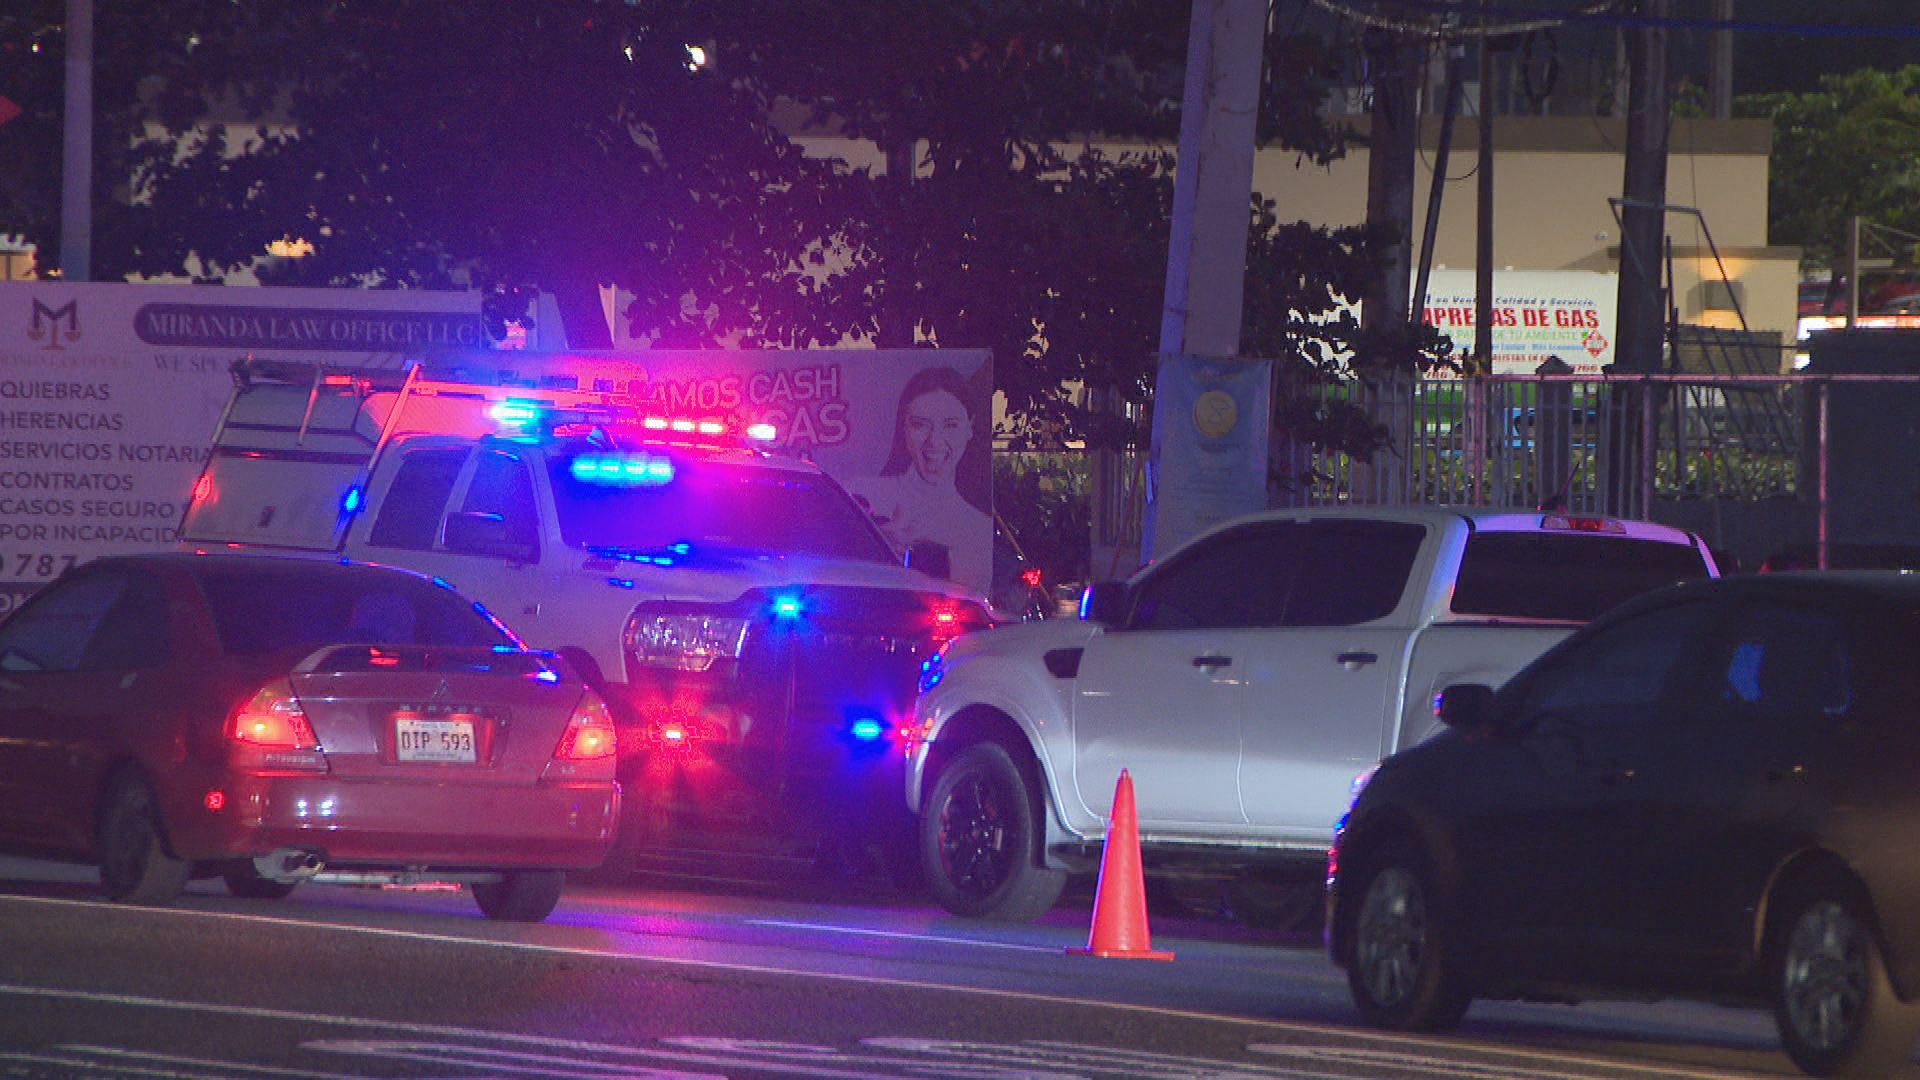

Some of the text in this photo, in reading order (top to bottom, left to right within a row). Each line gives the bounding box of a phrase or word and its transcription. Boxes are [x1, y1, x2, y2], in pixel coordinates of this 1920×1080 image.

[148, 312, 264, 339] MIRANDA
[269, 316, 324, 342] LAW
[329, 318, 421, 343] OFFICE
[1522, 307, 1550, 328] DE
[1555, 308, 1600, 329] GAS
[0, 381, 111, 401] QUIEBRAS
[648, 366, 840, 412] AMOS CASH
[0, 411, 124, 431] HERENCIAS
[0, 442, 214, 463] SERVICIOS NOTARIA
[0, 472, 134, 491] CONTRATOS
[0, 500, 75, 516] CASOS
[81, 501, 175, 518] SEGURO
[0, 524, 179, 543] POR INCAPACID
[441, 732, 470, 751] 593
